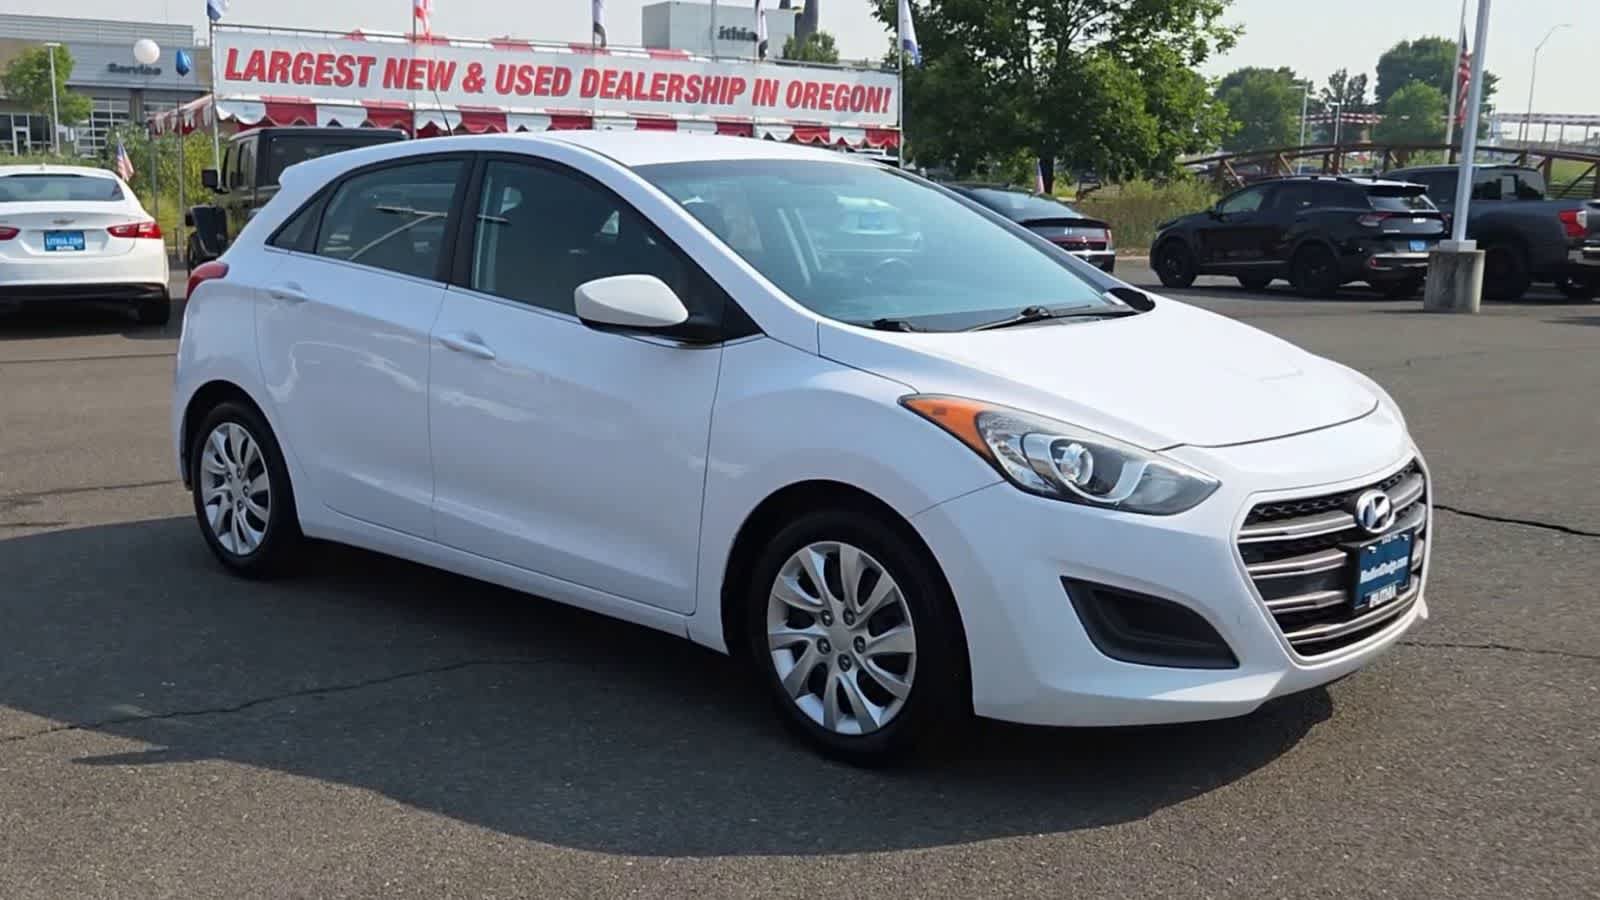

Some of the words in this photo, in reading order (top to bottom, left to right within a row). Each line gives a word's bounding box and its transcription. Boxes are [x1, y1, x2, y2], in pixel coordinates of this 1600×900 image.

[712, 26, 758, 41] ithia
[107, 63, 162, 75] Service
[224, 48, 376, 88] LARGEST
[383, 57, 457, 90] NEW
[461, 62, 486, 94] &
[494, 64, 572, 97] USED
[580, 68, 747, 105] DEALERSHIP
[752, 78, 780, 107] IN
[785, 80, 892, 113] OREGON!
